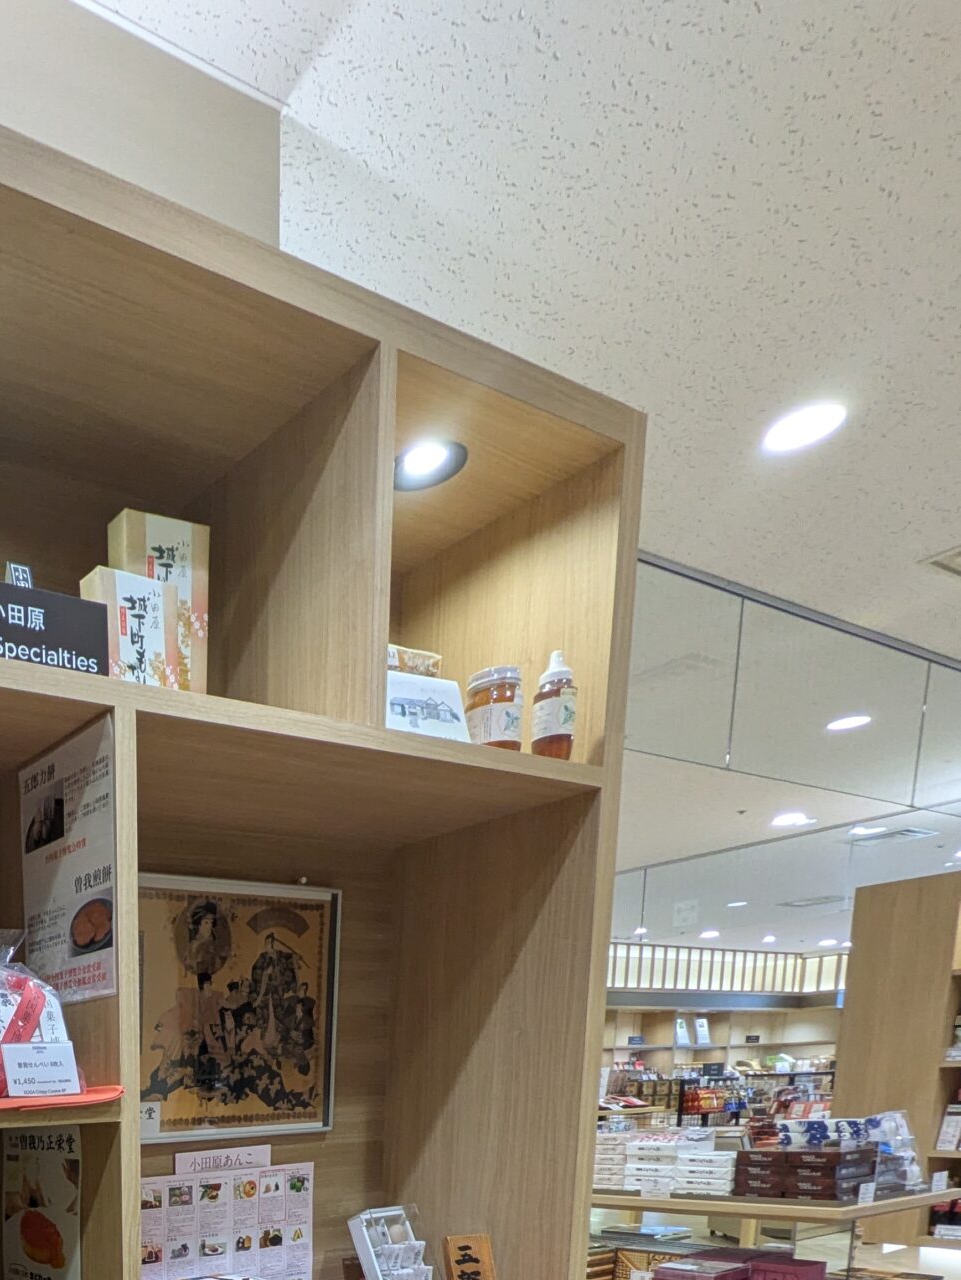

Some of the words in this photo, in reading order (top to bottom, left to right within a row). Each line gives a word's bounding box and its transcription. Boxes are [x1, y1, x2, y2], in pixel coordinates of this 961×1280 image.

[74, 864, 113, 894] 曽我煎餅
[190, 1152, 254, 1172] 小田原あんこ
